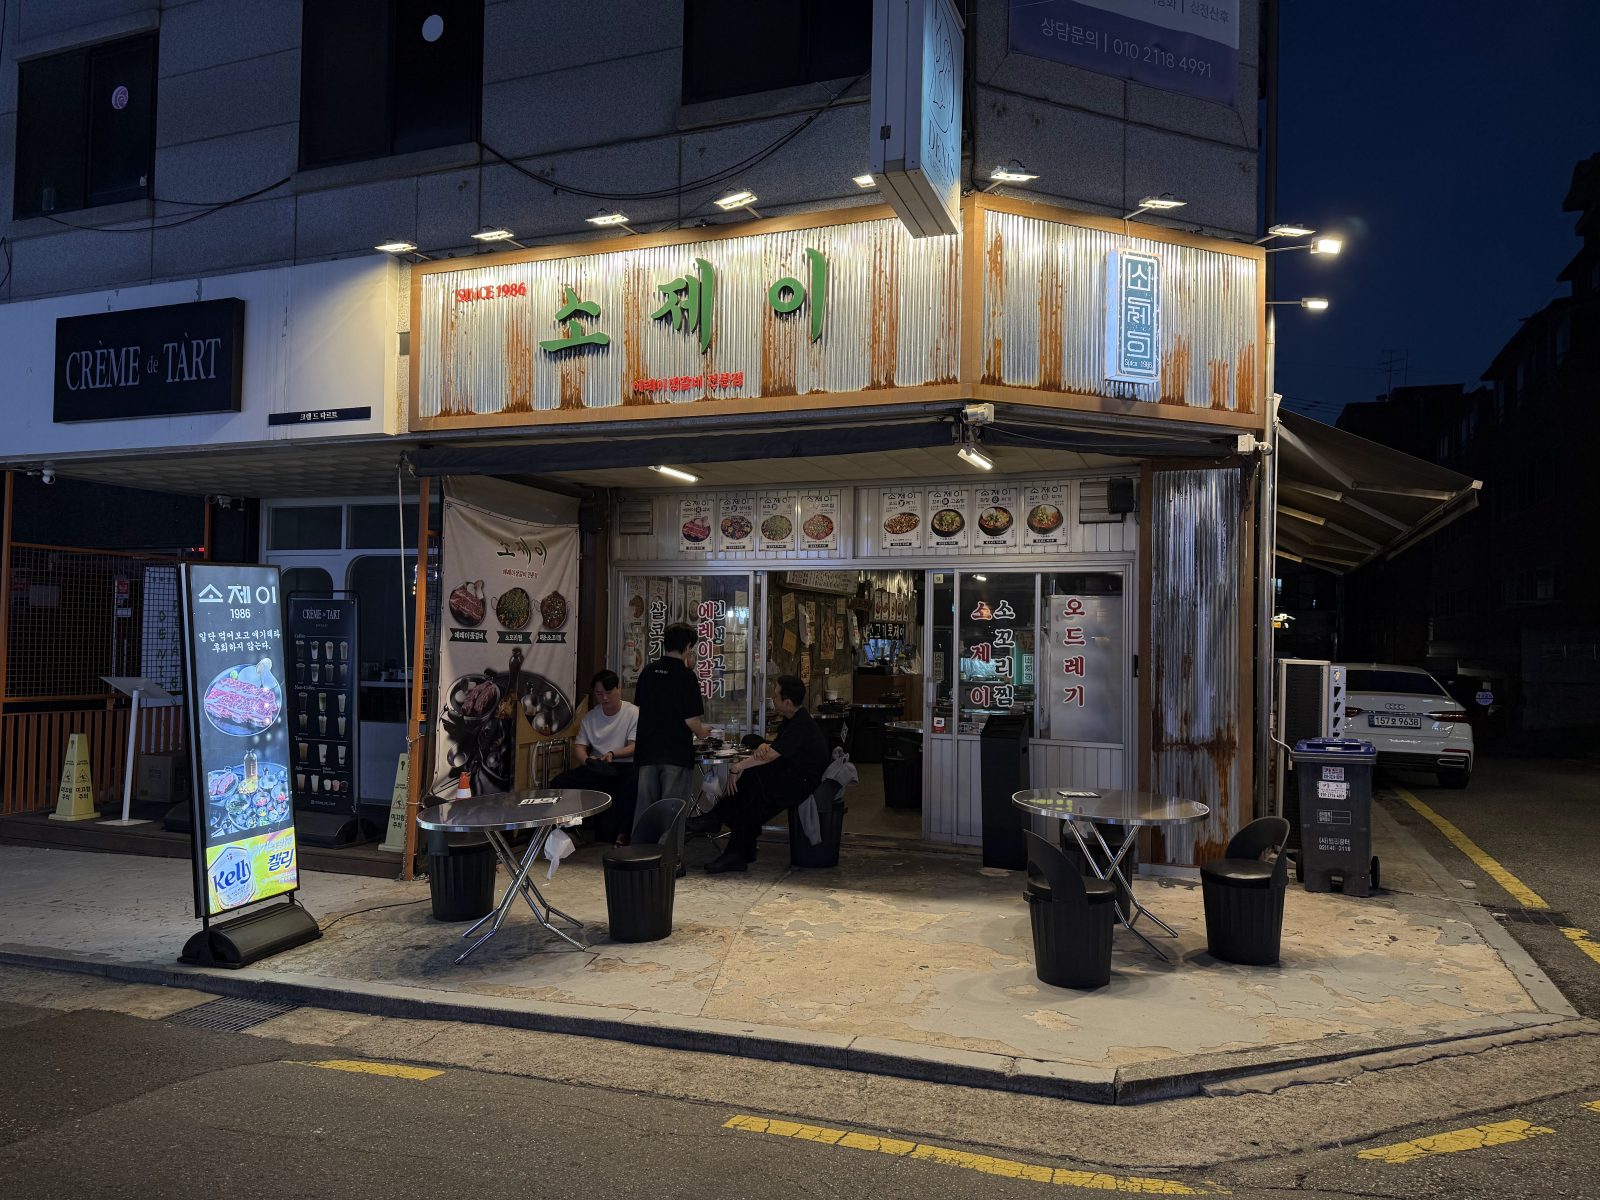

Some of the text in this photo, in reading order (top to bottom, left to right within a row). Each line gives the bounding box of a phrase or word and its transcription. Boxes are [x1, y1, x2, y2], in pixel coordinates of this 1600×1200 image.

[1041, 16, 1213, 79] 상담문의 010 2118 4991
[456, 282, 527, 303] SINCE 1986
[66, 339, 142, 392] CRÈME
[147, 355, 159, 374] de
[198, 583, 277, 604] 소제이
[229, 608, 251, 620] 1986
[199, 631, 216, 643] 일단
[648, 600, 668, 664] 살코기
[970, 600, 993, 708] 소제이
[1063, 598, 1087, 708] 오드레기
[212, 858, 251, 893] Kelly
[267, 848, 294, 872] 켈리
